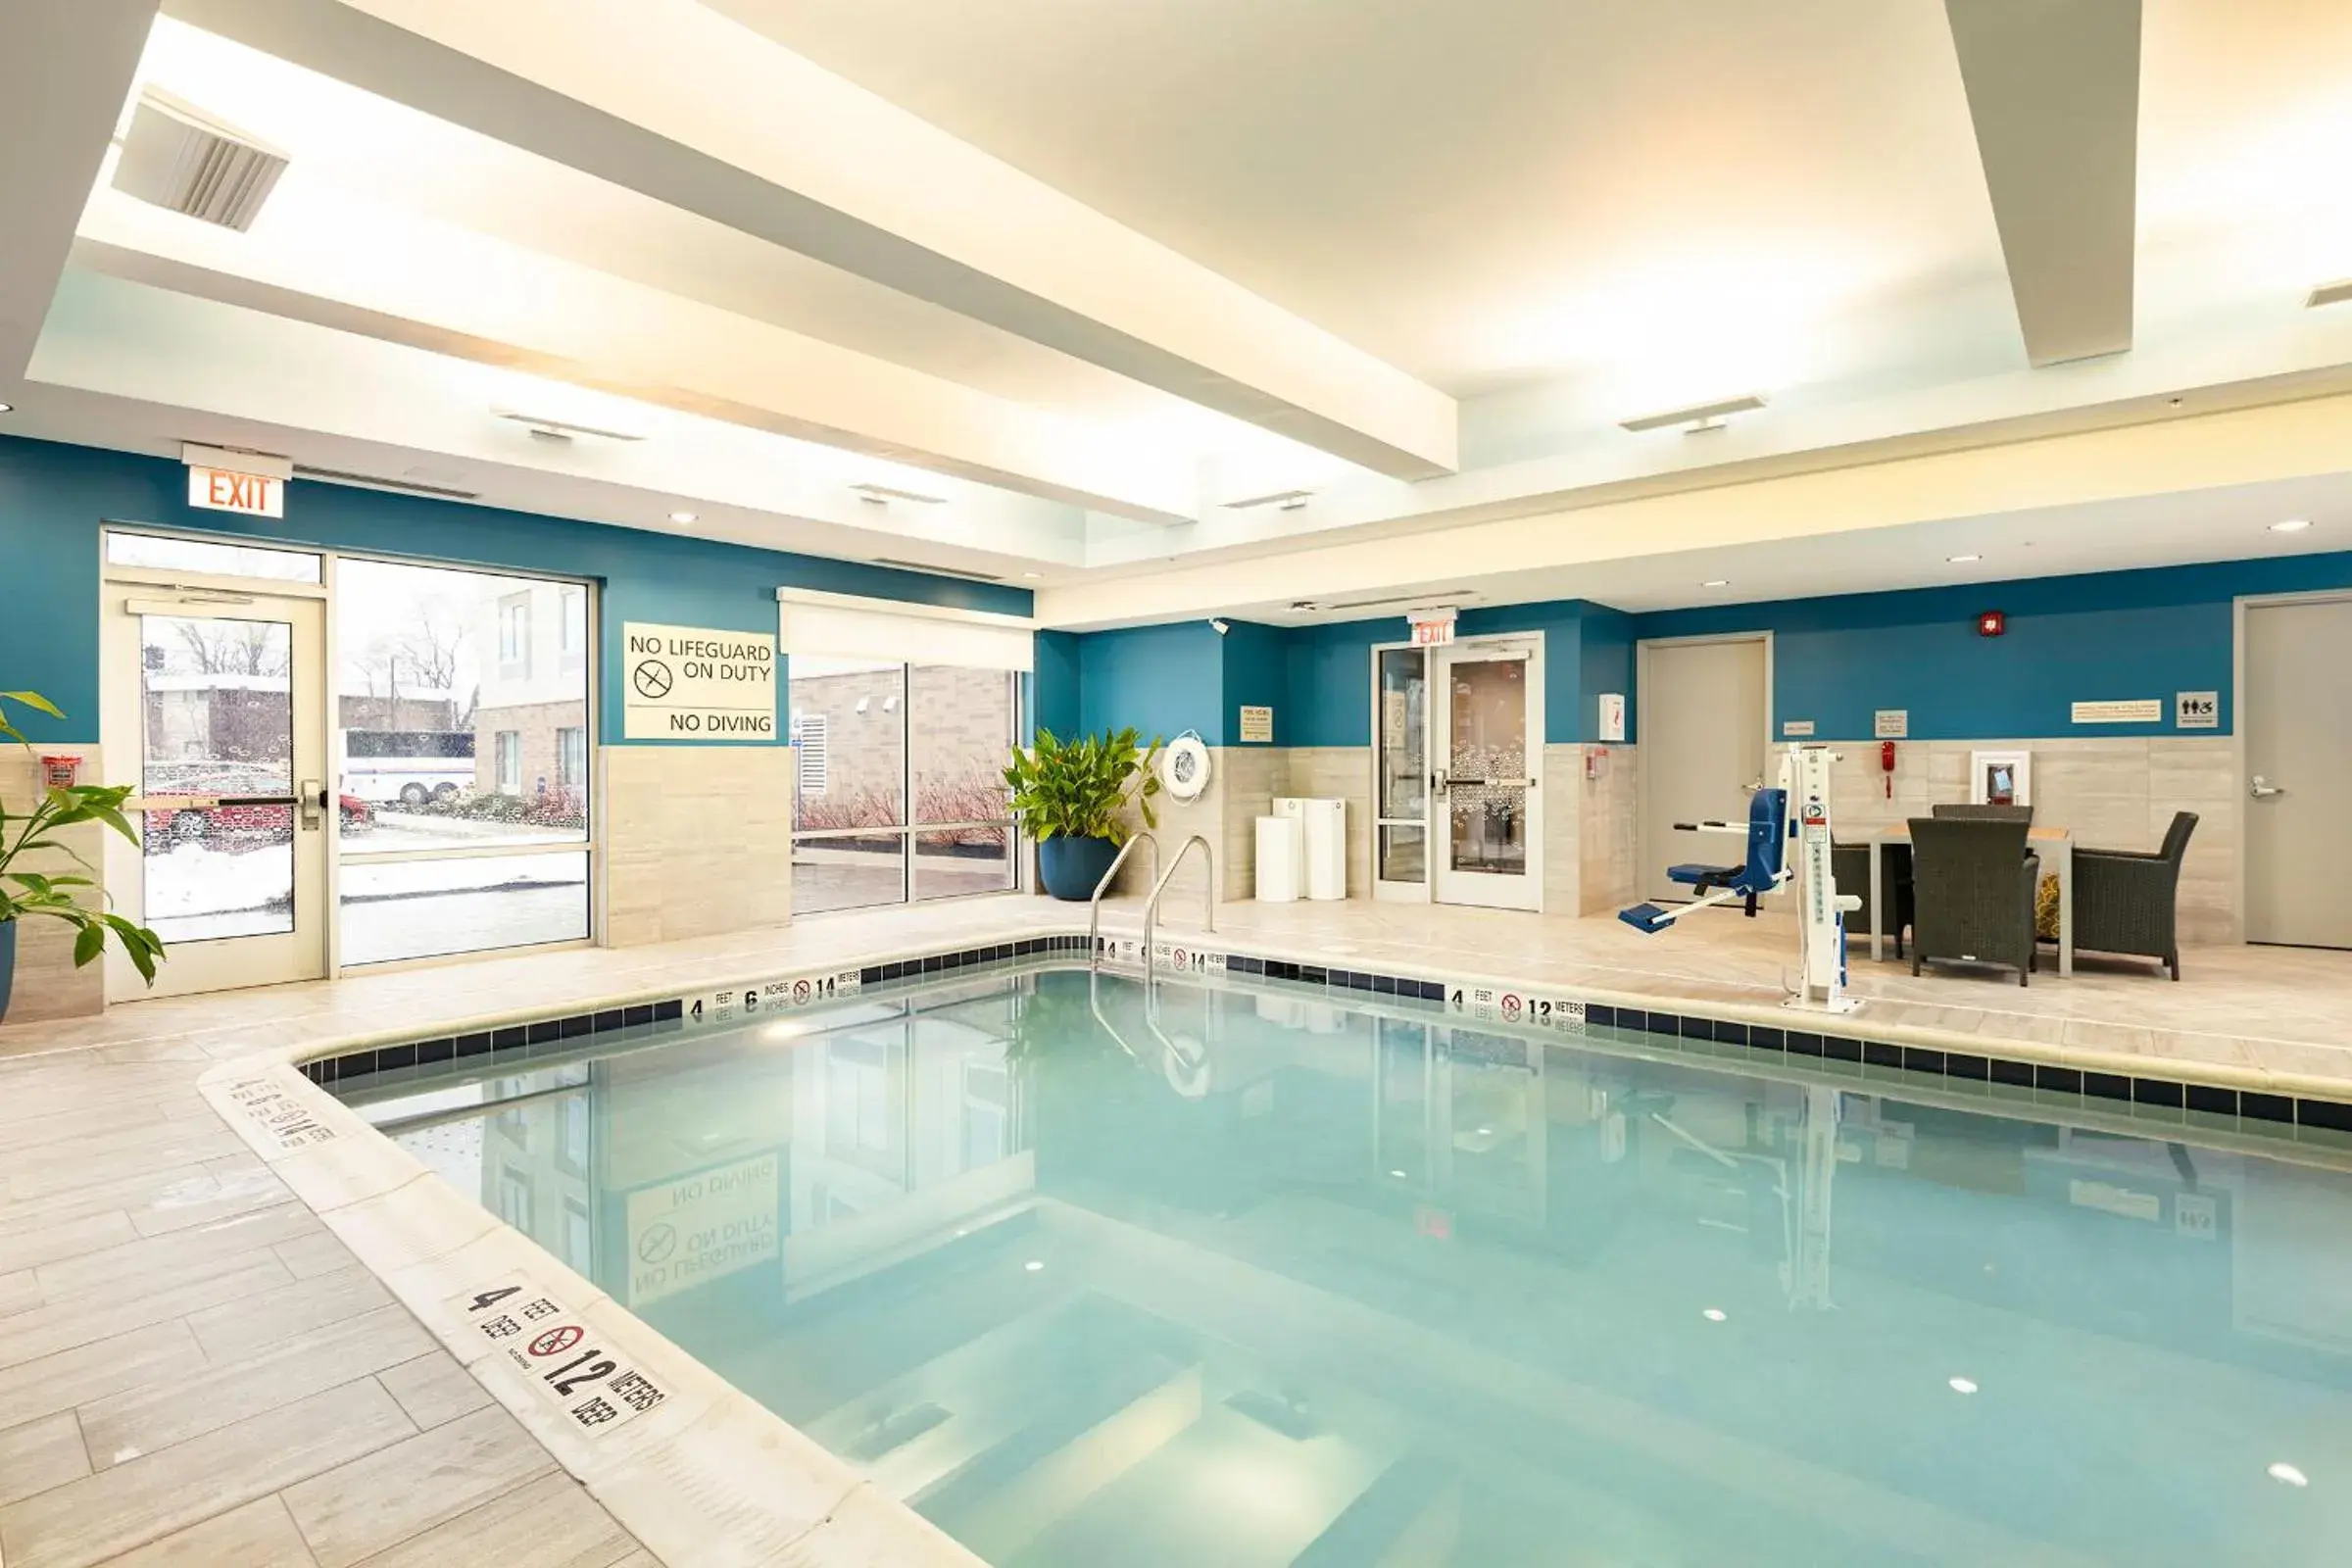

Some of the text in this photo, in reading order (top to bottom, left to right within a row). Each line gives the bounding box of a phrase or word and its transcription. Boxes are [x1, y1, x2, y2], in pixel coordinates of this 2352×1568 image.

[210, 470, 270, 510] EXIT
[1419, 622, 1448, 644] EXIT
[631, 636, 770, 662] NO LIFEGUARD
[683, 662, 770, 681] ON DUTY
[670, 714, 770, 732] NO DIVING
[838, 970, 859, 983] METERS
[690, 982, 790, 1014] 4 FEET 6 INCHES
[1475, 989, 1493, 1002] FEET
[1554, 1001, 1585, 1015] METERS
[467, 1286, 561, 1322] 4 FEET
[480, 1314, 522, 1340] DEEP
[607, 1368, 665, 1412] METERS
[570, 1396, 618, 1428] DEEP
